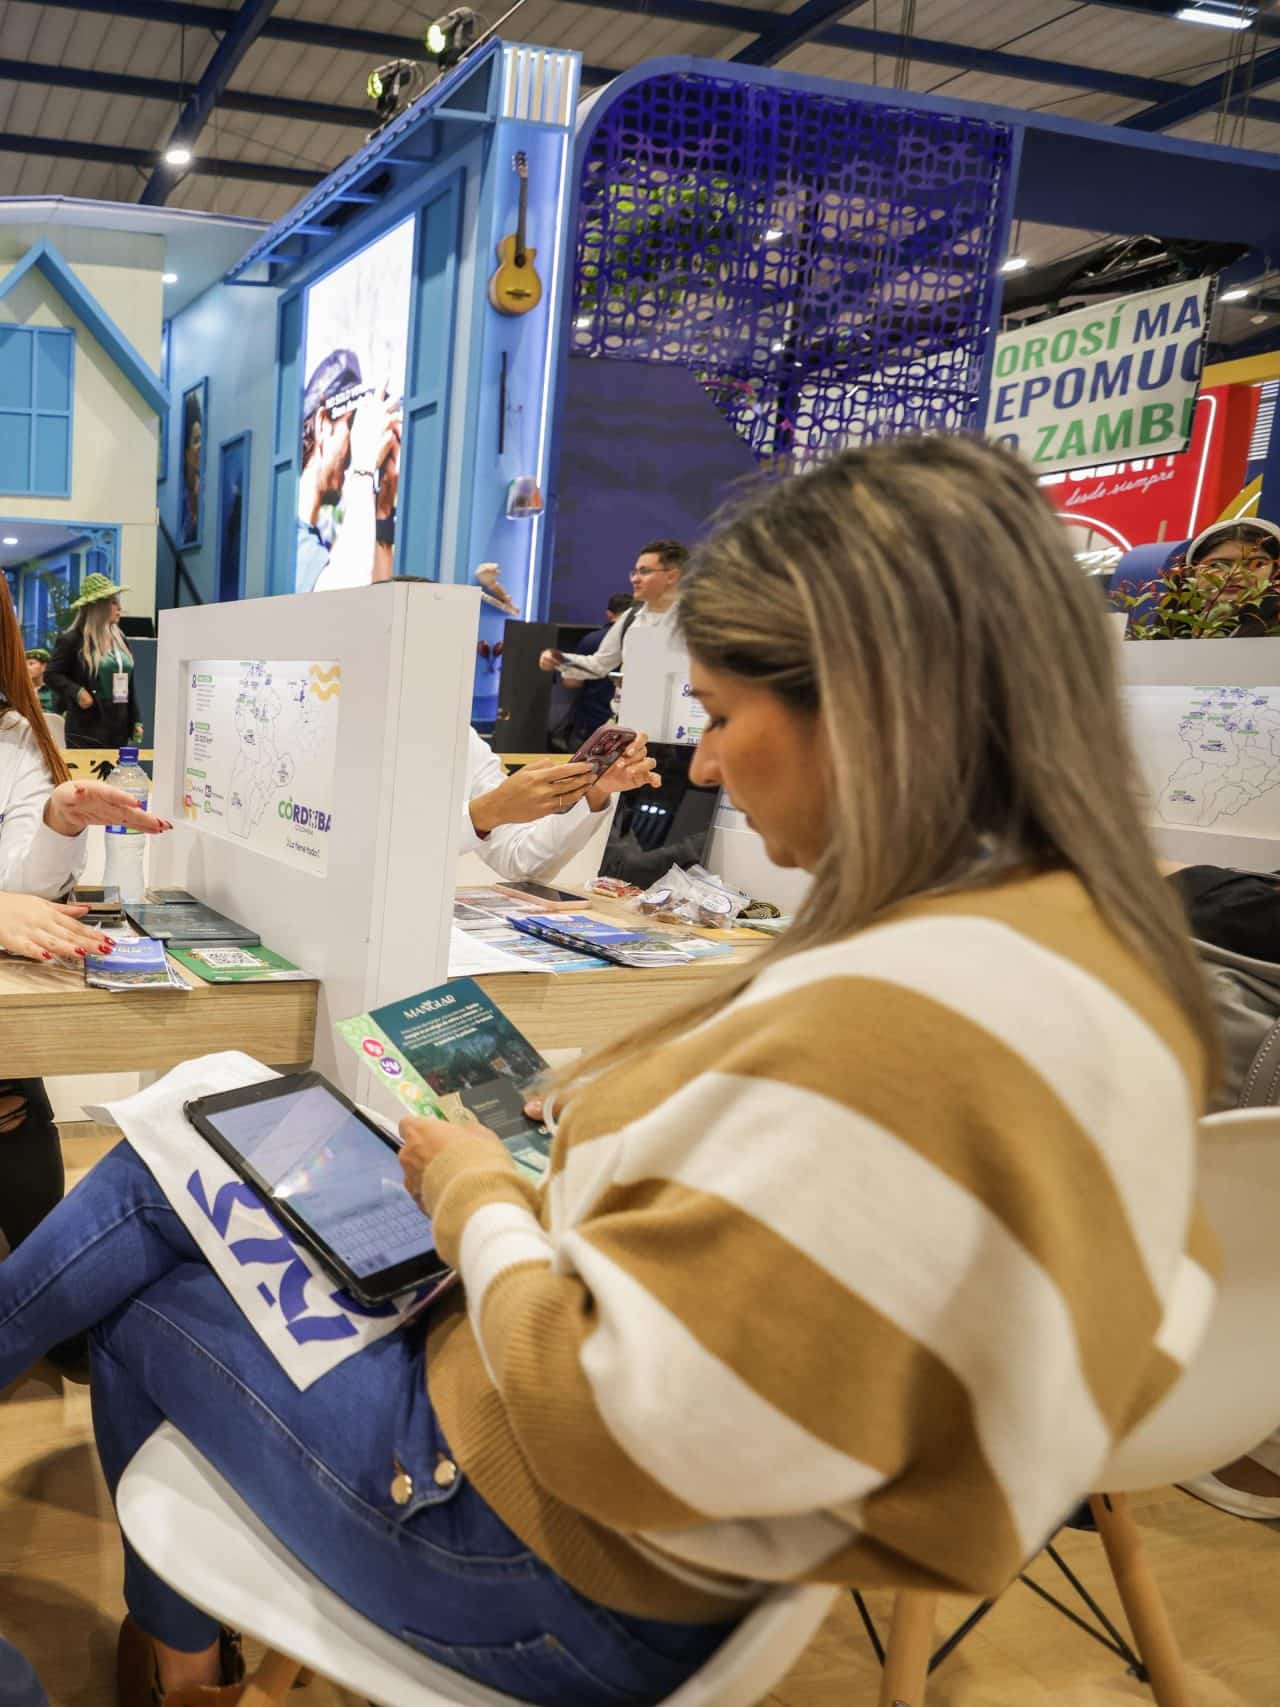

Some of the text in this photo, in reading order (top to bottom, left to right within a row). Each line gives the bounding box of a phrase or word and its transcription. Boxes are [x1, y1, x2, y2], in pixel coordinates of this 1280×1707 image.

[995, 295, 1201, 380] OROSÍ MA
[403, 994, 456, 1019] MANGLAR
